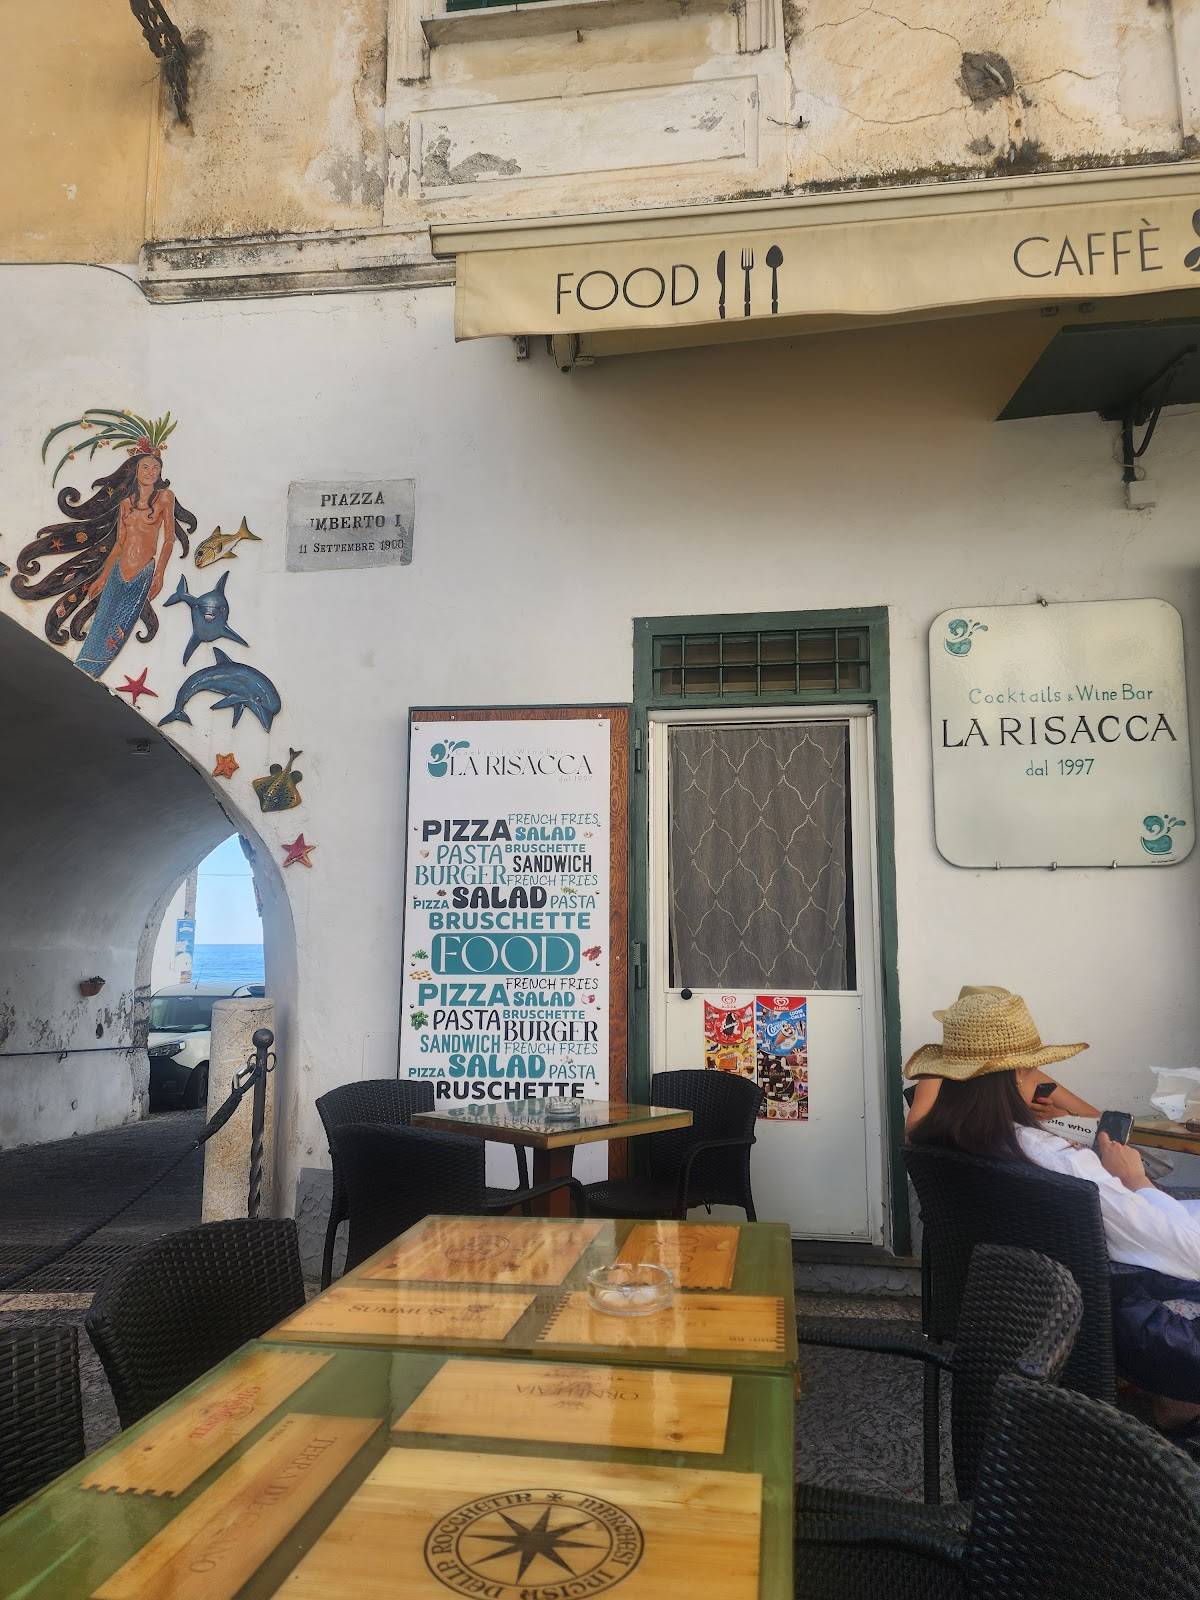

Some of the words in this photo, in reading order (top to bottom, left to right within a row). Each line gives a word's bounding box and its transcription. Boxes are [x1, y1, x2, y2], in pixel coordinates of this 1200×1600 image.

[1012, 218, 1164, 280] CAFFÈ
[555, 262, 700, 315] FOOD
[320, 491, 385, 507] PIAZZA
[968, 686, 1062, 705] Cocktails
[1075, 684, 1118, 702] Wine
[1122, 683, 1153, 701] Bar
[942, 718, 989, 748] LA
[999, 713, 1178, 746] RISACCA
[450, 756, 479, 776] LA
[486, 755, 593, 776] RISACCA
[1025, 760, 1049, 776] dal
[1057, 758, 1095, 776] 1997
[508, 813, 557, 825] FRENCH
[561, 813, 599, 825] FRIES
[422, 819, 512, 842] PIZZA
[515, 826, 576, 841] SALAD
[437, 844, 503, 865] PASTA
[505, 843, 586, 853] BRUSCHETTE
[513, 855, 592, 873] SANDWICH
[415, 864, 507, 886] BURGER
[507, 874, 556, 886] FRENCH
[560, 874, 598, 886] FRIES
[413, 899, 450, 910] PIZZA
[452, 886, 548, 909] SALAD
[550, 895, 596, 909] PASTA
[429, 911, 591, 930] BRUSCHETTE
[439, 935, 575, 973] FOOD
[506, 978, 556, 990] FRENCH
[560, 978, 599, 990] FRIES
[418, 983, 510, 1007] PIZZA
[513, 991, 576, 1007] SALAD
[433, 1009, 501, 1031] PASTA
[503, 1010, 586, 1020] BRUSCHETTE
[504, 1020, 599, 1043] BURGER
[420, 1034, 501, 1053] SANDWICH
[504, 1043, 555, 1055] FRENCH
[559, 1043, 598, 1055] FRIES
[408, 1067, 446, 1078] PIZZA
[448, 1054, 546, 1079] SALAD
[549, 1065, 596, 1080] PASTA
[436, 1081, 585, 1100] RUSCHETTE
[1067, 1122, 1092, 1135] who
